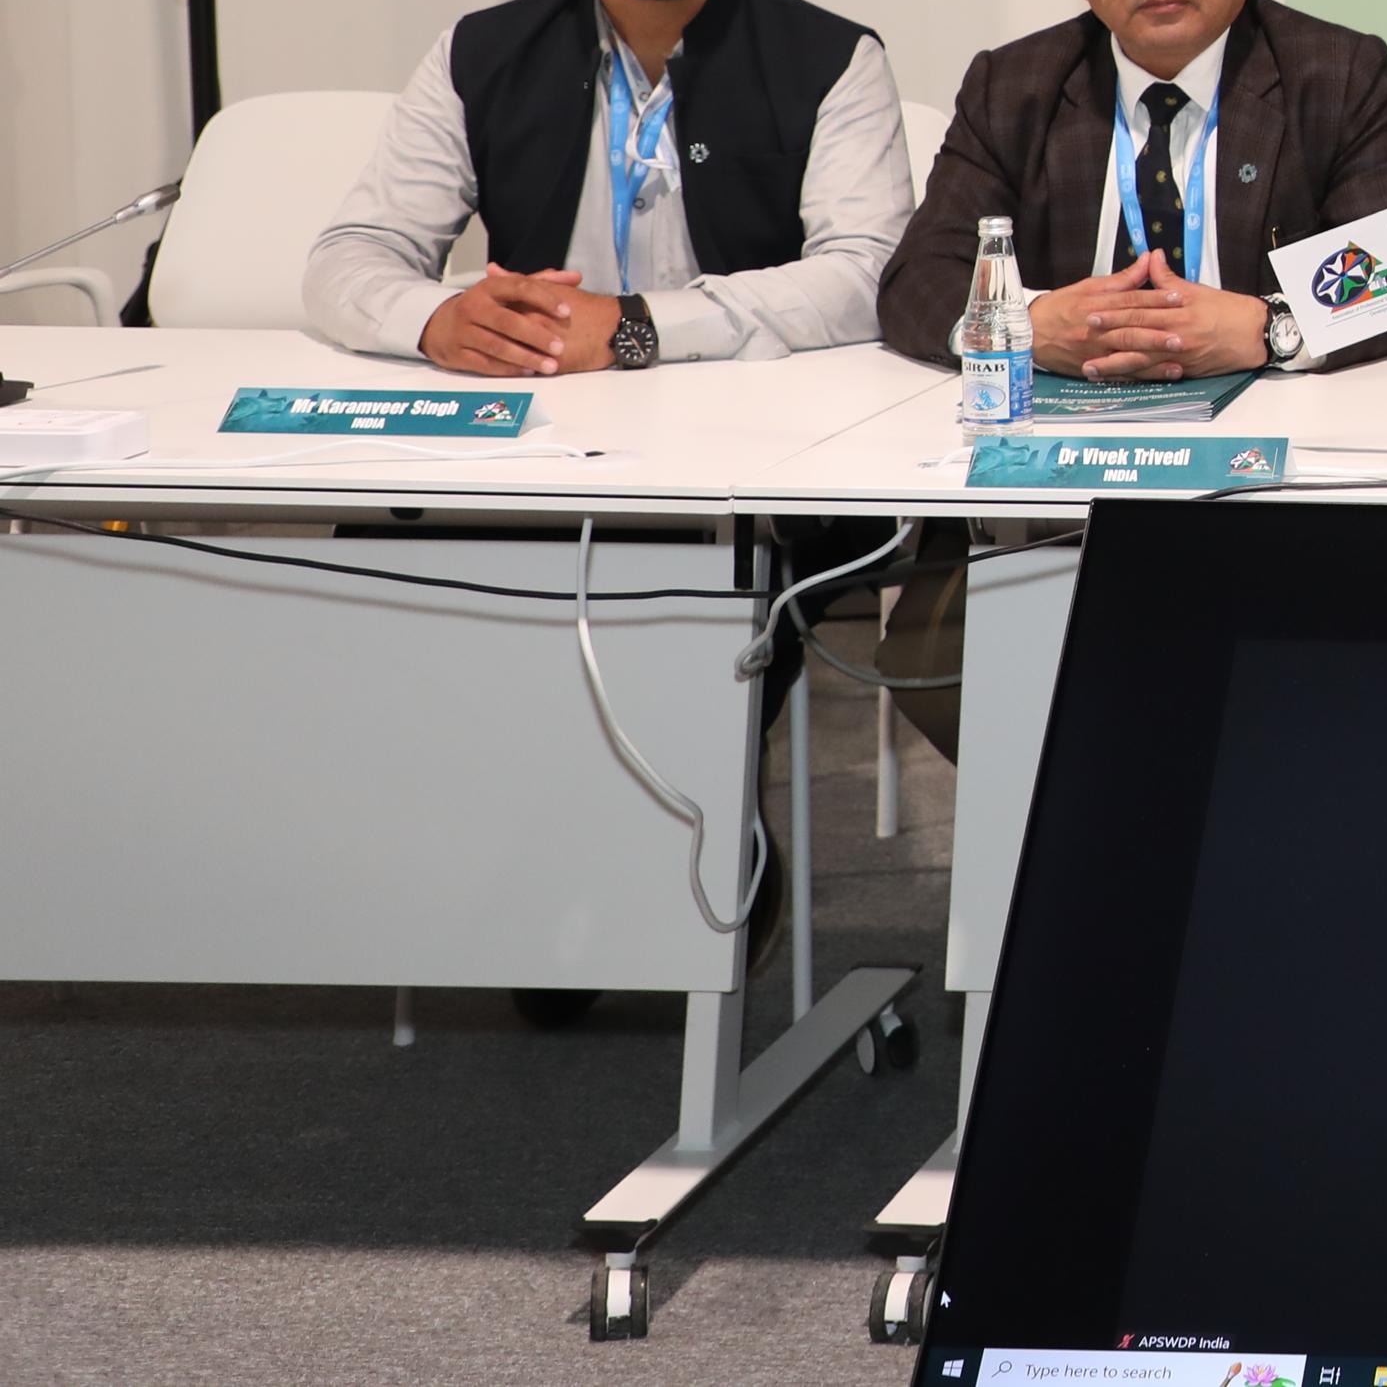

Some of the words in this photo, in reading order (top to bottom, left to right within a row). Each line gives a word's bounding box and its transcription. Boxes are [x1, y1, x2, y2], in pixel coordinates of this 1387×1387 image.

[290, 398, 318, 414] Mr
[317, 399, 409, 415] Karamveer
[410, 399, 459, 417] Singh
[351, 417, 385, 429] INDIA
[1057, 448, 1079, 465] Dr
[1082, 448, 1131, 466] Vivek
[1133, 448, 1191, 466] Trivedi
[1103, 469, 1138, 482] INDIA
[1138, 1336, 1197, 1349] APSWDP
[1198, 1337, 1230, 1350] India
[1026, 1364, 1060, 1380] Type
[1064, 1364, 1099, 1378] here
[1103, 1366, 1119, 1378] to
[1122, 1365, 1173, 1379] search
